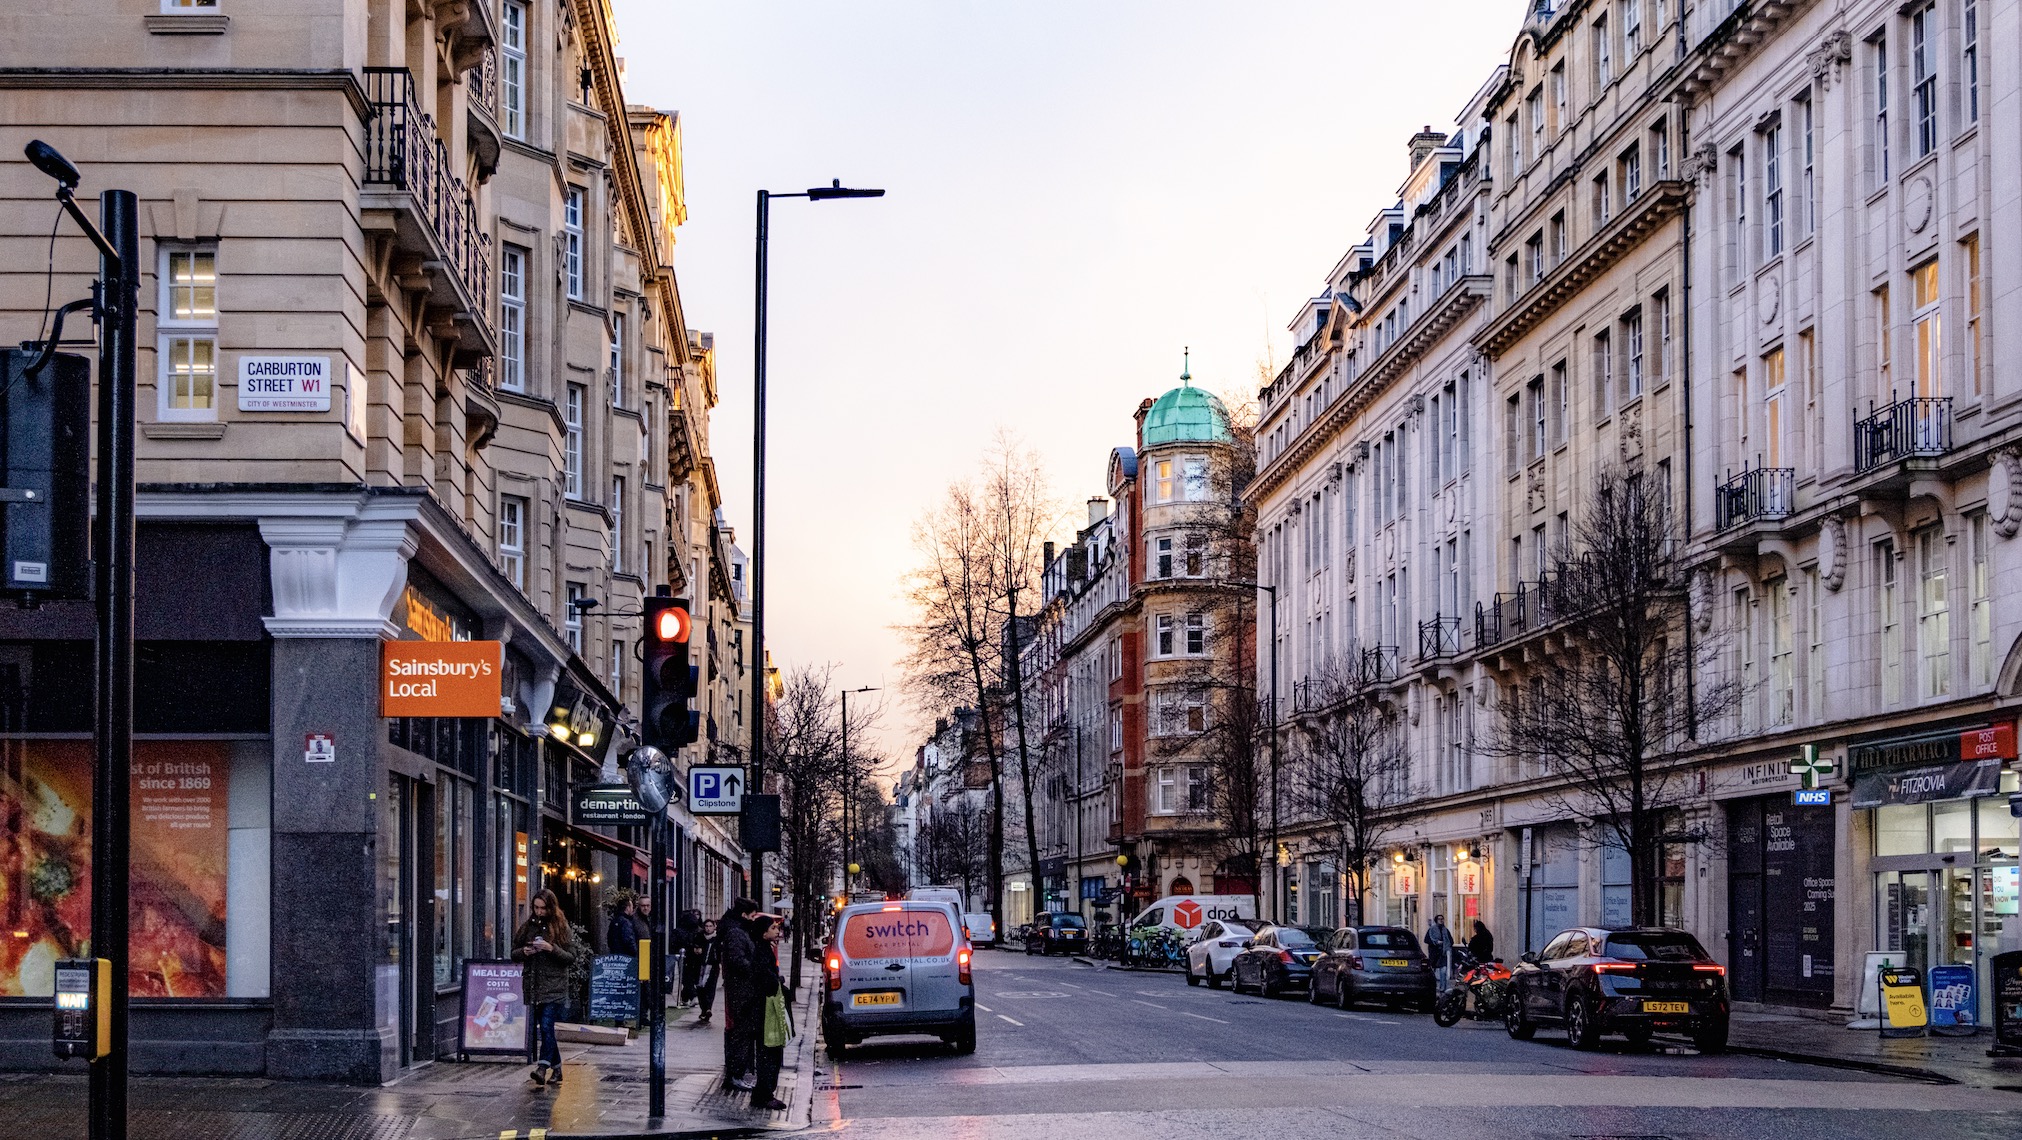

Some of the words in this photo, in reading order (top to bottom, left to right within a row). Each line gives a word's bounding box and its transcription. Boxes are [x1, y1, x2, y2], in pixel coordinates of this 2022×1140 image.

[248, 362, 321, 376] CARBURTON
[248, 379, 294, 392] STREET
[301, 379, 320, 392] W1
[389, 659, 492, 679] Sainsbury's
[389, 679, 437, 697] Local
[1978, 731, 1995, 743] POST
[1884, 740, 1951, 767] PHARMACY
[1975, 742, 1997, 755] OFFICE
[147, 762, 162, 775] of
[164, 762, 211, 775] British
[1743, 762, 1788, 780] INFINIT
[139, 777, 176, 789] since
[179, 777, 211, 789] 1869
[699, 775, 716, 796] P
[1751, 775, 1788, 785] MOTORCYCLES
[1900, 774, 1946, 794] FITZROVIA
[698, 800, 736, 808] Clipstone
[1798, 792, 1827, 803] NHS
[193, 805, 210, 813] bring
[580, 798, 646, 811] demartin
[1766, 812, 1783, 826] Retail
[1770, 826, 1791, 841] Space
[1766, 838, 1796, 851] Available
[1803, 877, 1819, 887] Office
[1818, 877, 1834, 889] Space
[1807, 889, 1827, 901] Coming
[1207, 906, 1238, 921] dpd
[866, 921, 929, 938] switch
[595, 955, 632, 966] DEMARTINO
[849, 957, 951, 967] SWITCHCARRENTAL.CO.UK
[472, 969, 499, 977] MEAL
[58, 993, 88, 1008] WAIT
[857, 995, 879, 1003] CE74
[880, 995, 896, 1003] YPV
[1647, 1003, 1668, 1011] LS72
[1670, 1003, 1685, 1011] TEV
